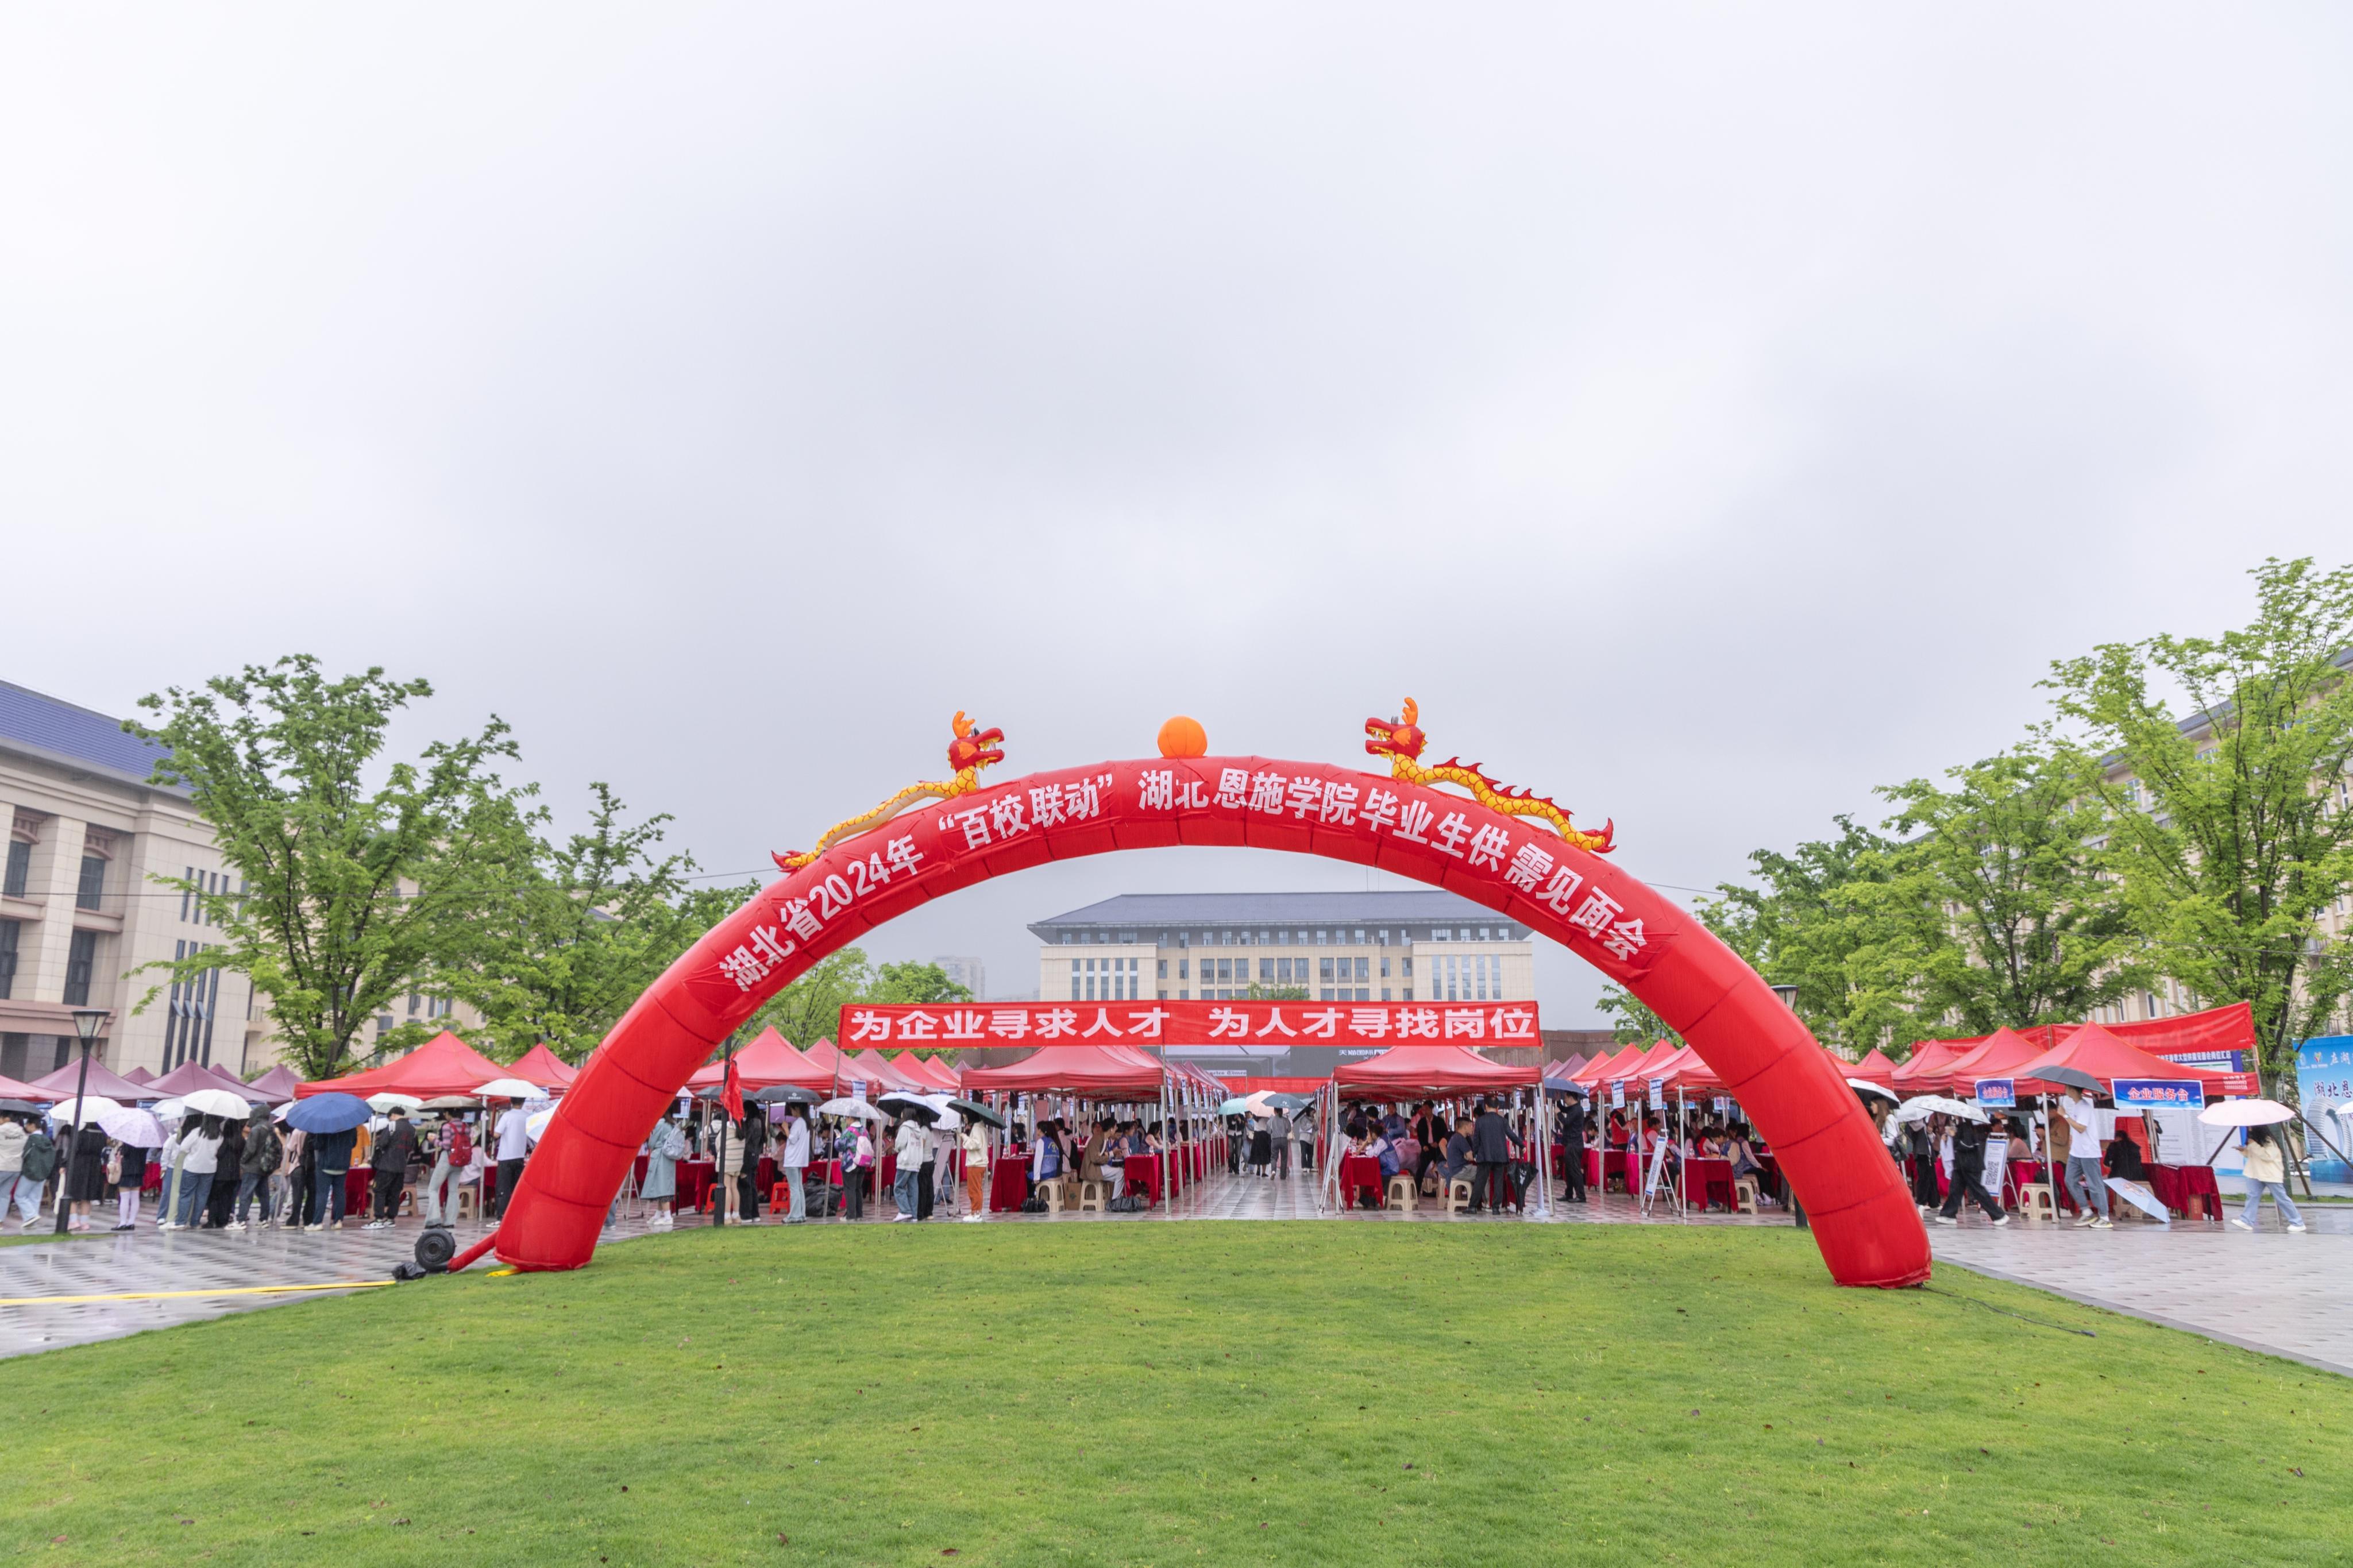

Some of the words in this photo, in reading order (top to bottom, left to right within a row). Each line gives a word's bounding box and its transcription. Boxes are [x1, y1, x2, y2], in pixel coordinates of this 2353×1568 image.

[719, 834, 924, 992] 湖北省2024年
[1138, 767, 1648, 961] 湖北恩施学院毕业生供需见面会
[851, 1007, 1170, 1041] 为企业寻求人才
[1209, 1007, 1535, 1038] 为人才寻找岗位
[2128, 1087, 2189, 1101] 企业服务台
